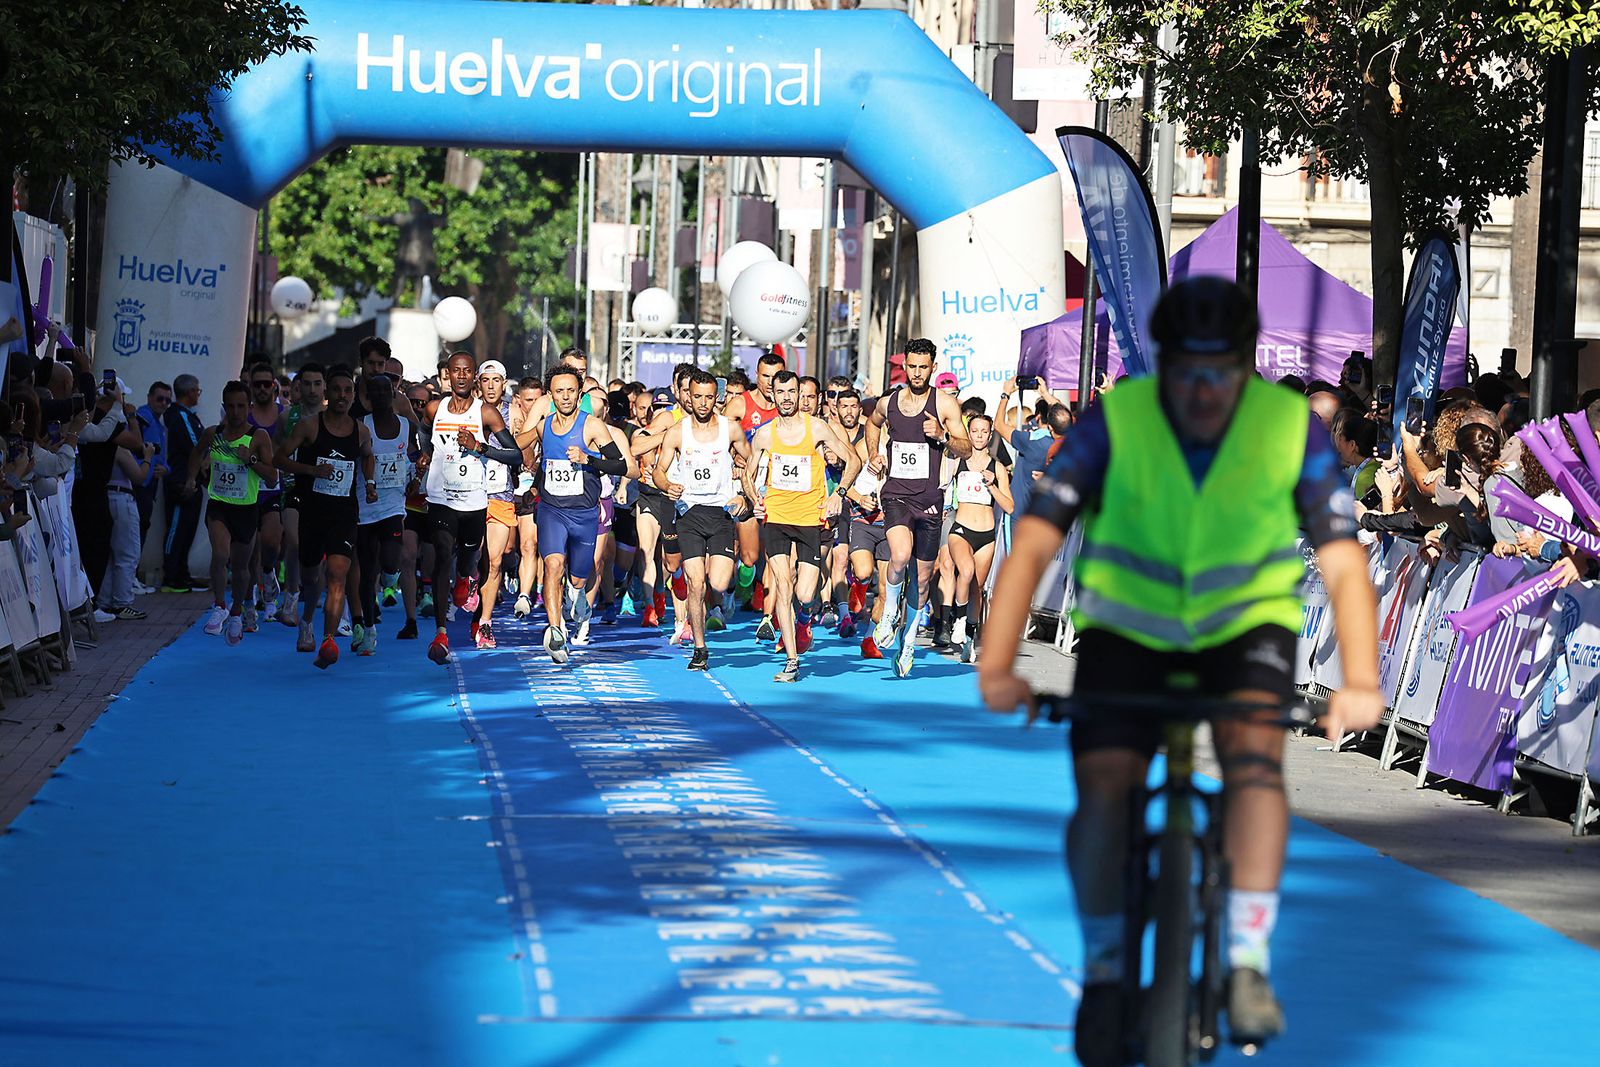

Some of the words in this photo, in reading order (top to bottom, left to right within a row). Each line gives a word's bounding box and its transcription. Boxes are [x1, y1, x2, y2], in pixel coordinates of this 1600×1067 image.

[356, 32, 581, 100] Huelva
[604, 44, 821, 118] original
[118, 254, 218, 288] Huelva
[180, 288, 216, 300] original
[760, 293, 808, 308] Goldfitness
[942, 287, 1039, 315] Huelva
[1411, 253, 1443, 396] YUNDAI
[150, 329, 201, 341] Ayuntamiento
[204, 334, 211, 342] de
[147, 339, 210, 356] HUELVA
[641, 350, 668, 364] Run
[669, 352, 683, 365] to
[980, 369, 1019, 382] HUE
[900, 453, 917, 465] 56
[380, 462, 398, 475] 74
[459, 464, 468, 476] 9
[694, 468, 711, 481] 68
[782, 464, 799, 477] 54
[219, 471, 236, 485] 49
[328, 469, 344, 483] 69
[548, 469, 578, 482] 1337
